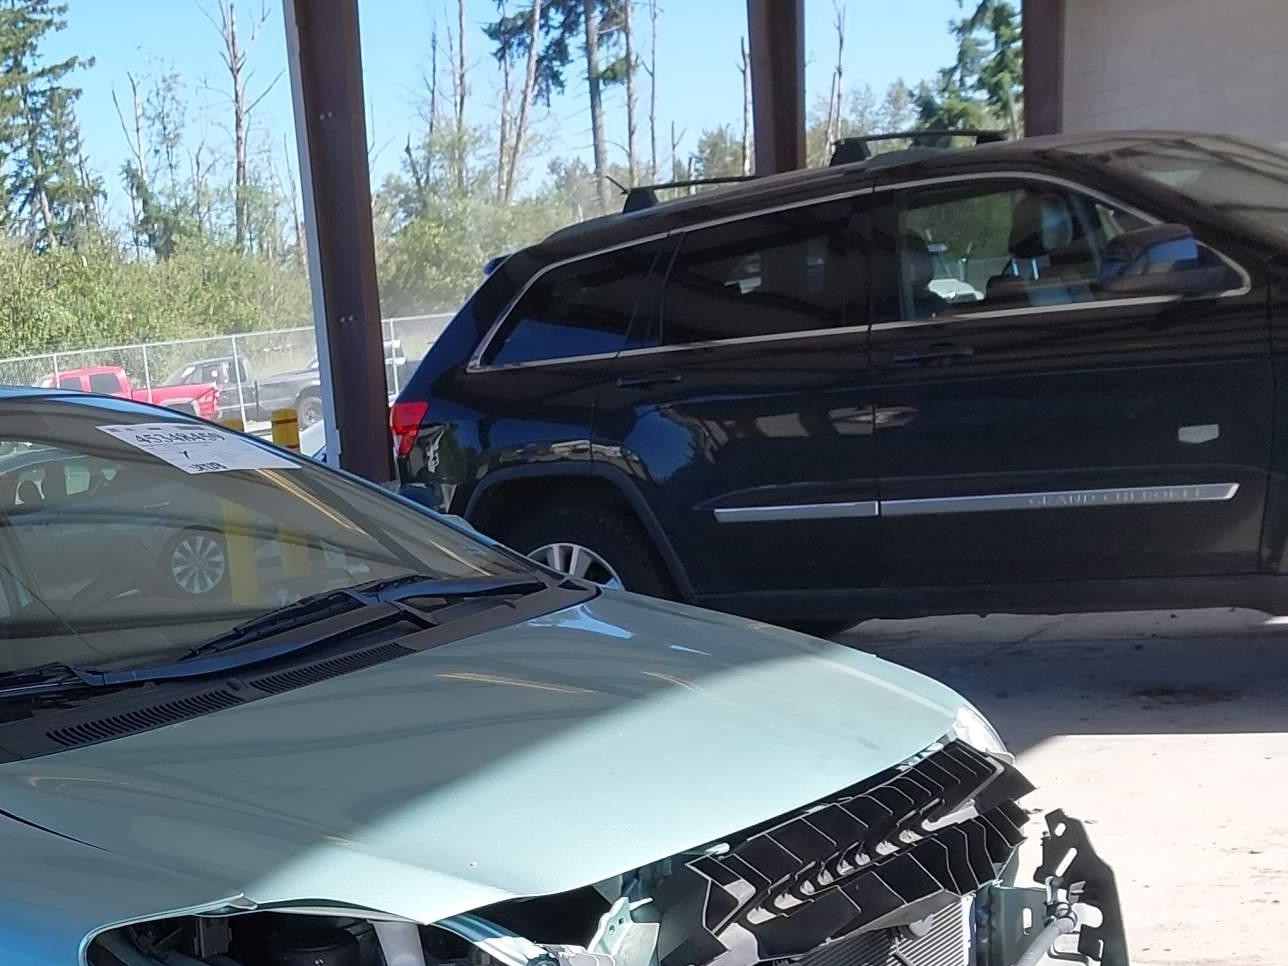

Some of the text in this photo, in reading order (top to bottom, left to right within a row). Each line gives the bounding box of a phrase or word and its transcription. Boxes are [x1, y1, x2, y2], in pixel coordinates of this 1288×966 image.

[135, 429, 226, 444] 45348459
[1029, 486, 1201, 506] GRAND CHEROKEE
